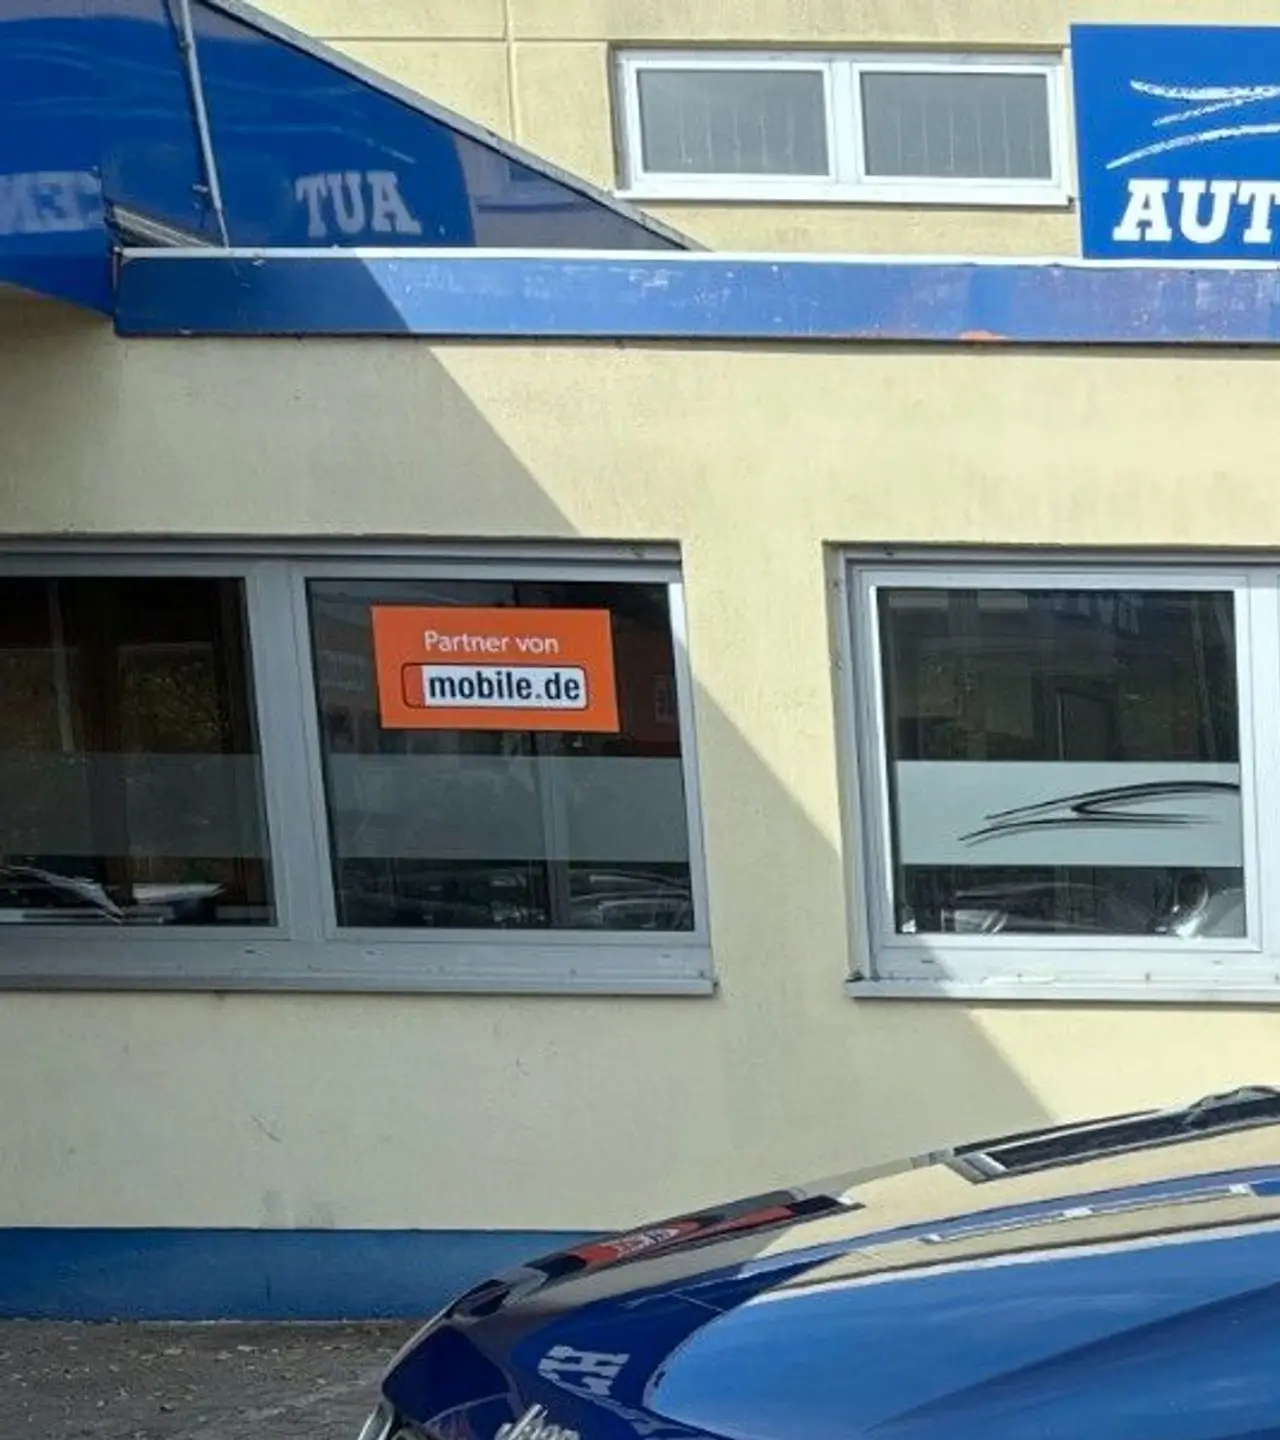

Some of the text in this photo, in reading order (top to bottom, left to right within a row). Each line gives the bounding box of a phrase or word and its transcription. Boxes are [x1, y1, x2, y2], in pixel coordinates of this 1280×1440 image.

[424, 630, 559, 654] Partner von
[429, 671, 581, 701] mobile.de
